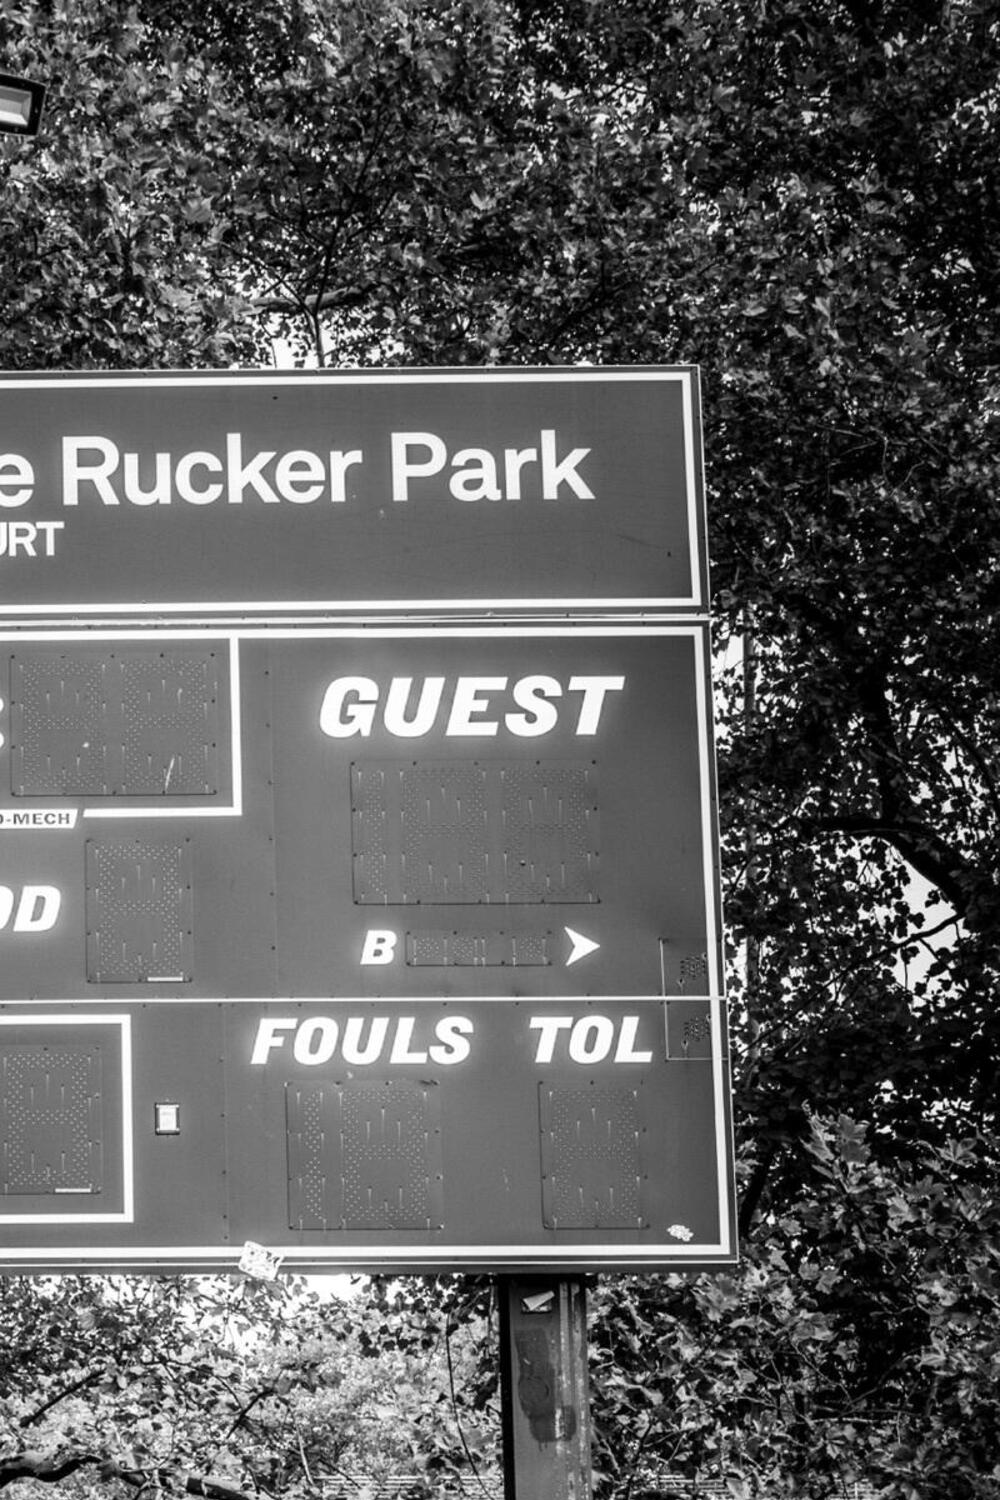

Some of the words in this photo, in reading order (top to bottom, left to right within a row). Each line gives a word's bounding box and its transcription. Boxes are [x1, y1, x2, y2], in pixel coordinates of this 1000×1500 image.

[62, 432, 363, 506] Rucker
[391, 429, 596, 502] Park
[318, 674, 625, 739] GUEST
[359, 929, 398, 966] B
[249, 1015, 474, 1066] FOULS
[528, 1014, 653, 1064] TOL
